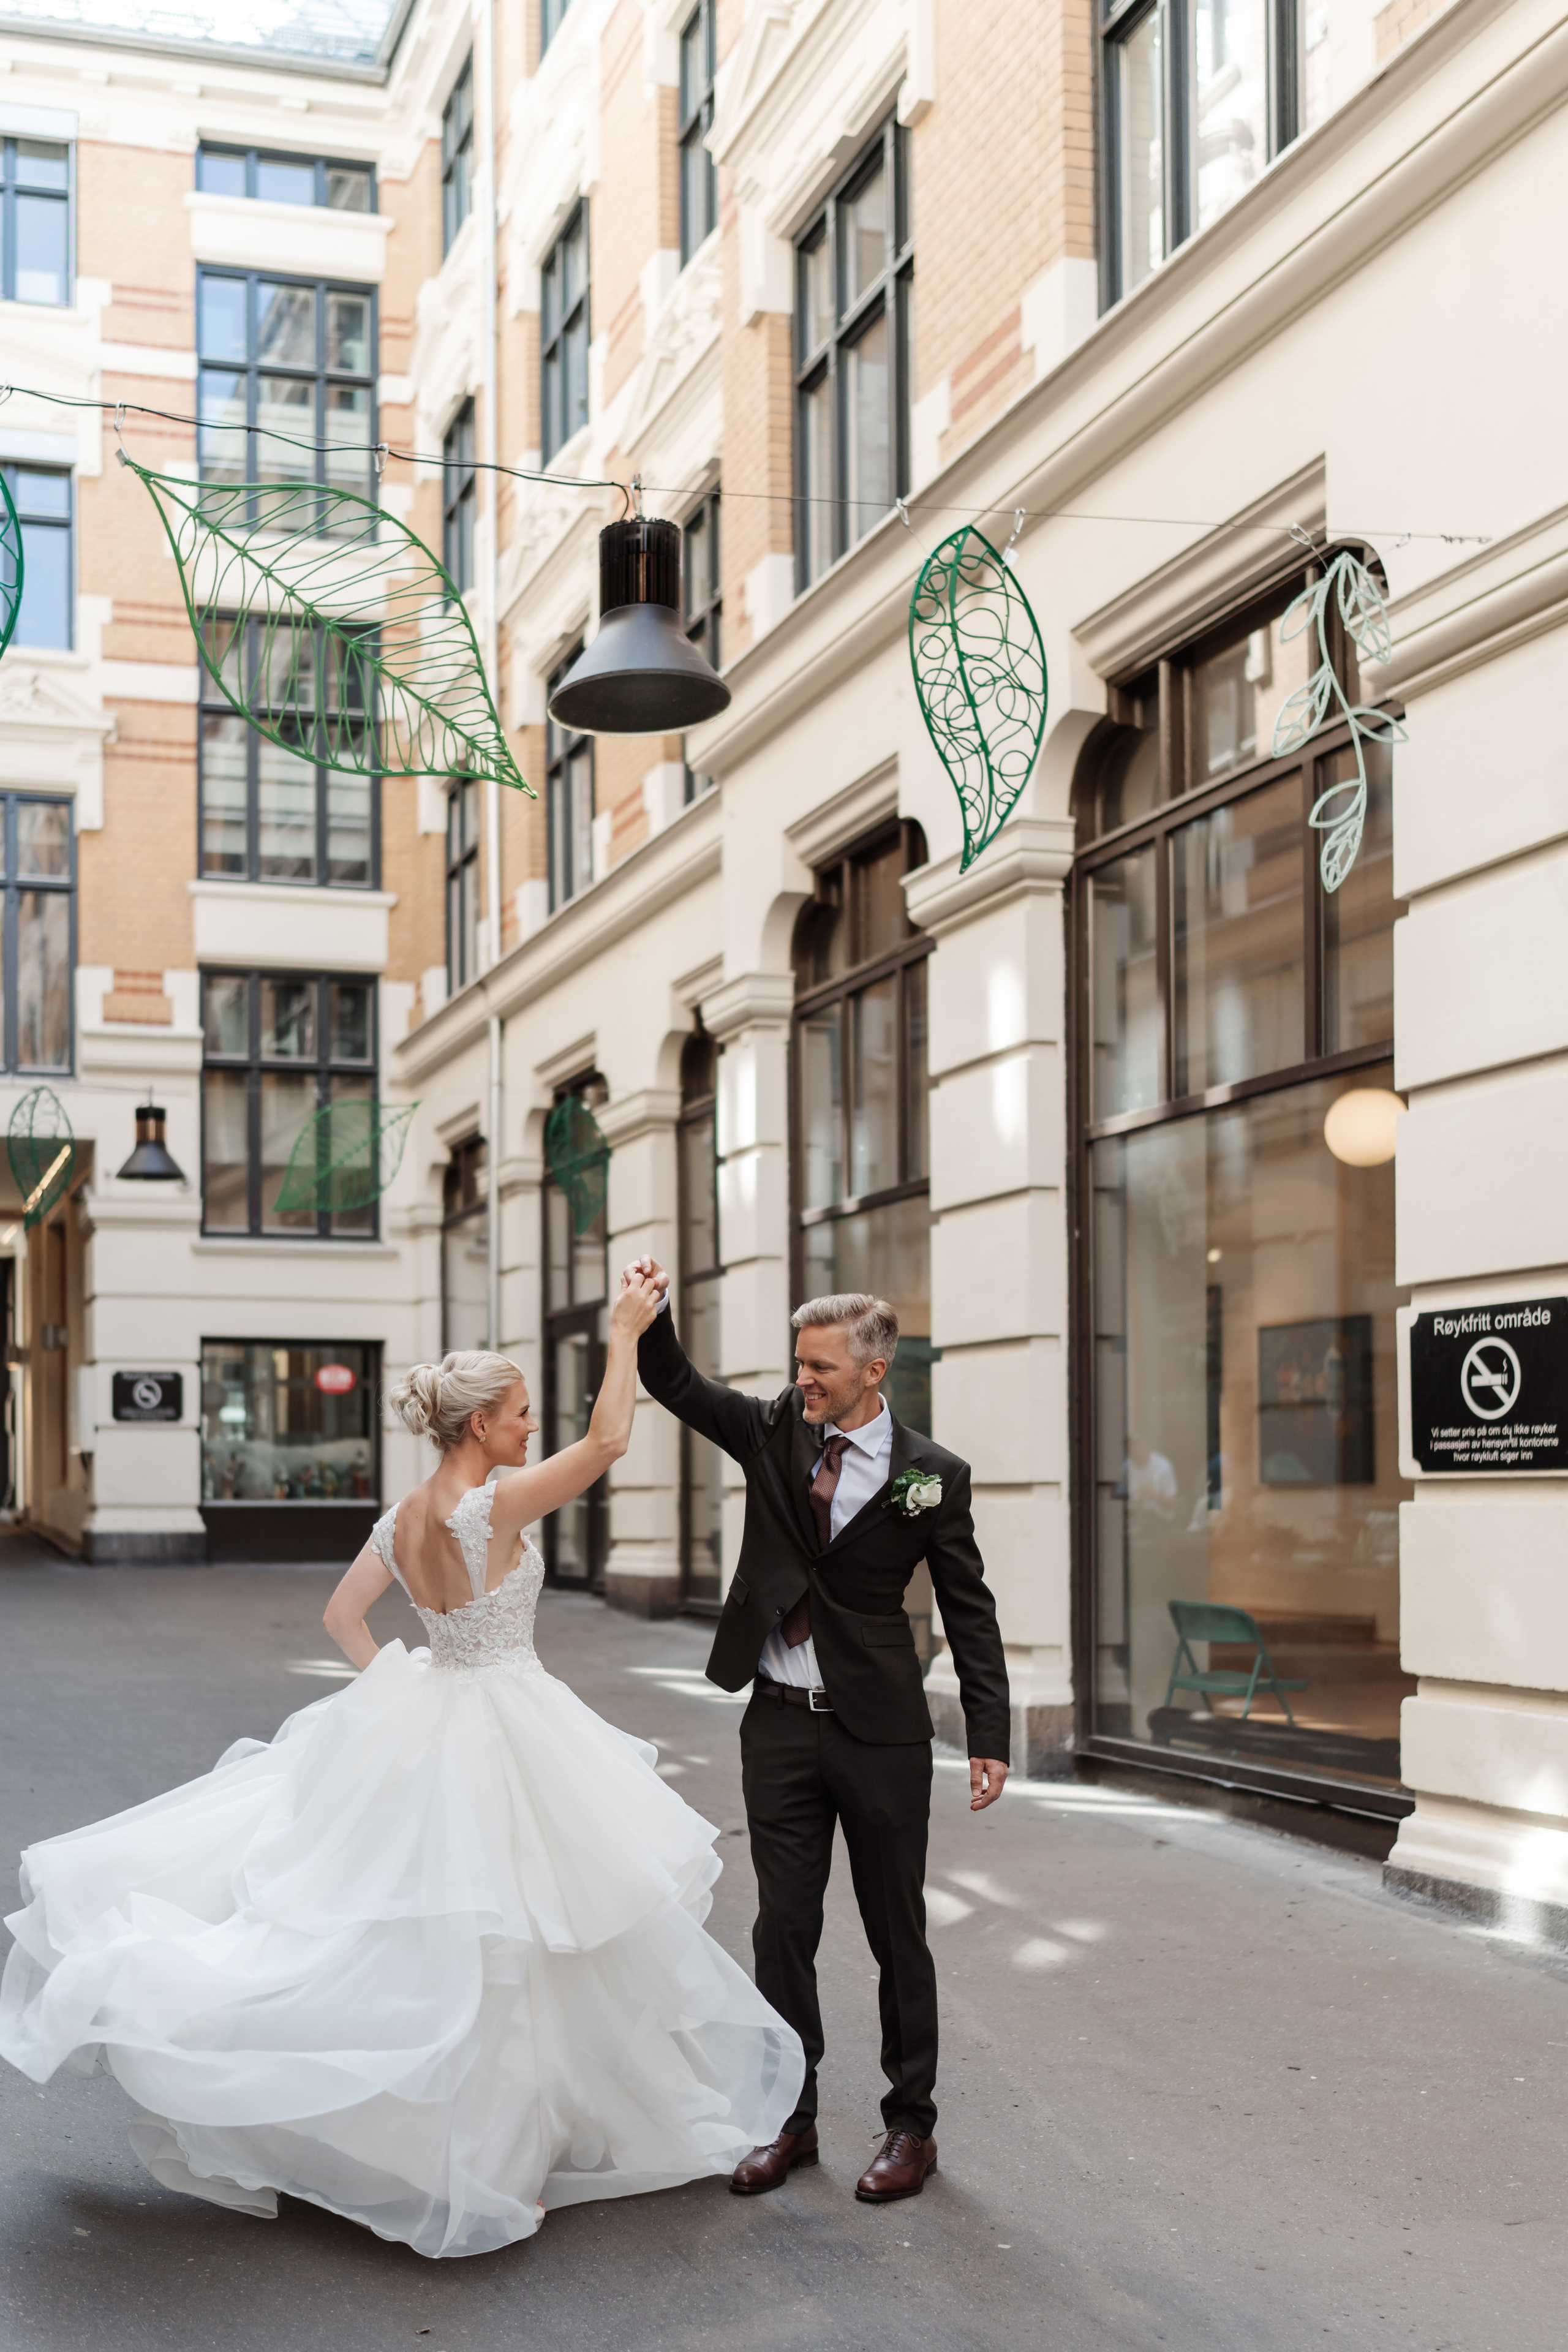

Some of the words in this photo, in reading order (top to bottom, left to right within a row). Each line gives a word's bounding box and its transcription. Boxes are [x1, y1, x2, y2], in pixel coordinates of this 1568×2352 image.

[1434, 1313, 1491, 1338] Røykfritt
[1494, 1306, 1551, 1330] område
[1431, 1427, 1439, 1438] Vi
[1440, 1427, 1461, 1438] setter
[1461, 1426, 1476, 1439] pris
[1477, 1425, 1487, 1438] på
[1488, 1426, 1501, 1436] om
[1502, 1423, 1512, 1436] du
[1513, 1423, 1530, 1434] ikke
[1531, 1422, 1558, 1436] røyker
[1430, 1439, 1433, 1450] i
[1434, 1439, 1471, 1452] passasjen
[1471, 1440, 1481, 1449] av
[1482, 1438, 1509, 1450] hensyn
[1520, 1436, 1559, 1447] kontorene
[1453, 1451, 1470, 1461] hvor
[1471, 1449, 1499, 1463] røykluft
[1500, 1450, 1520, 1463] siger
[1520, 1449, 1533, 1460] inn
